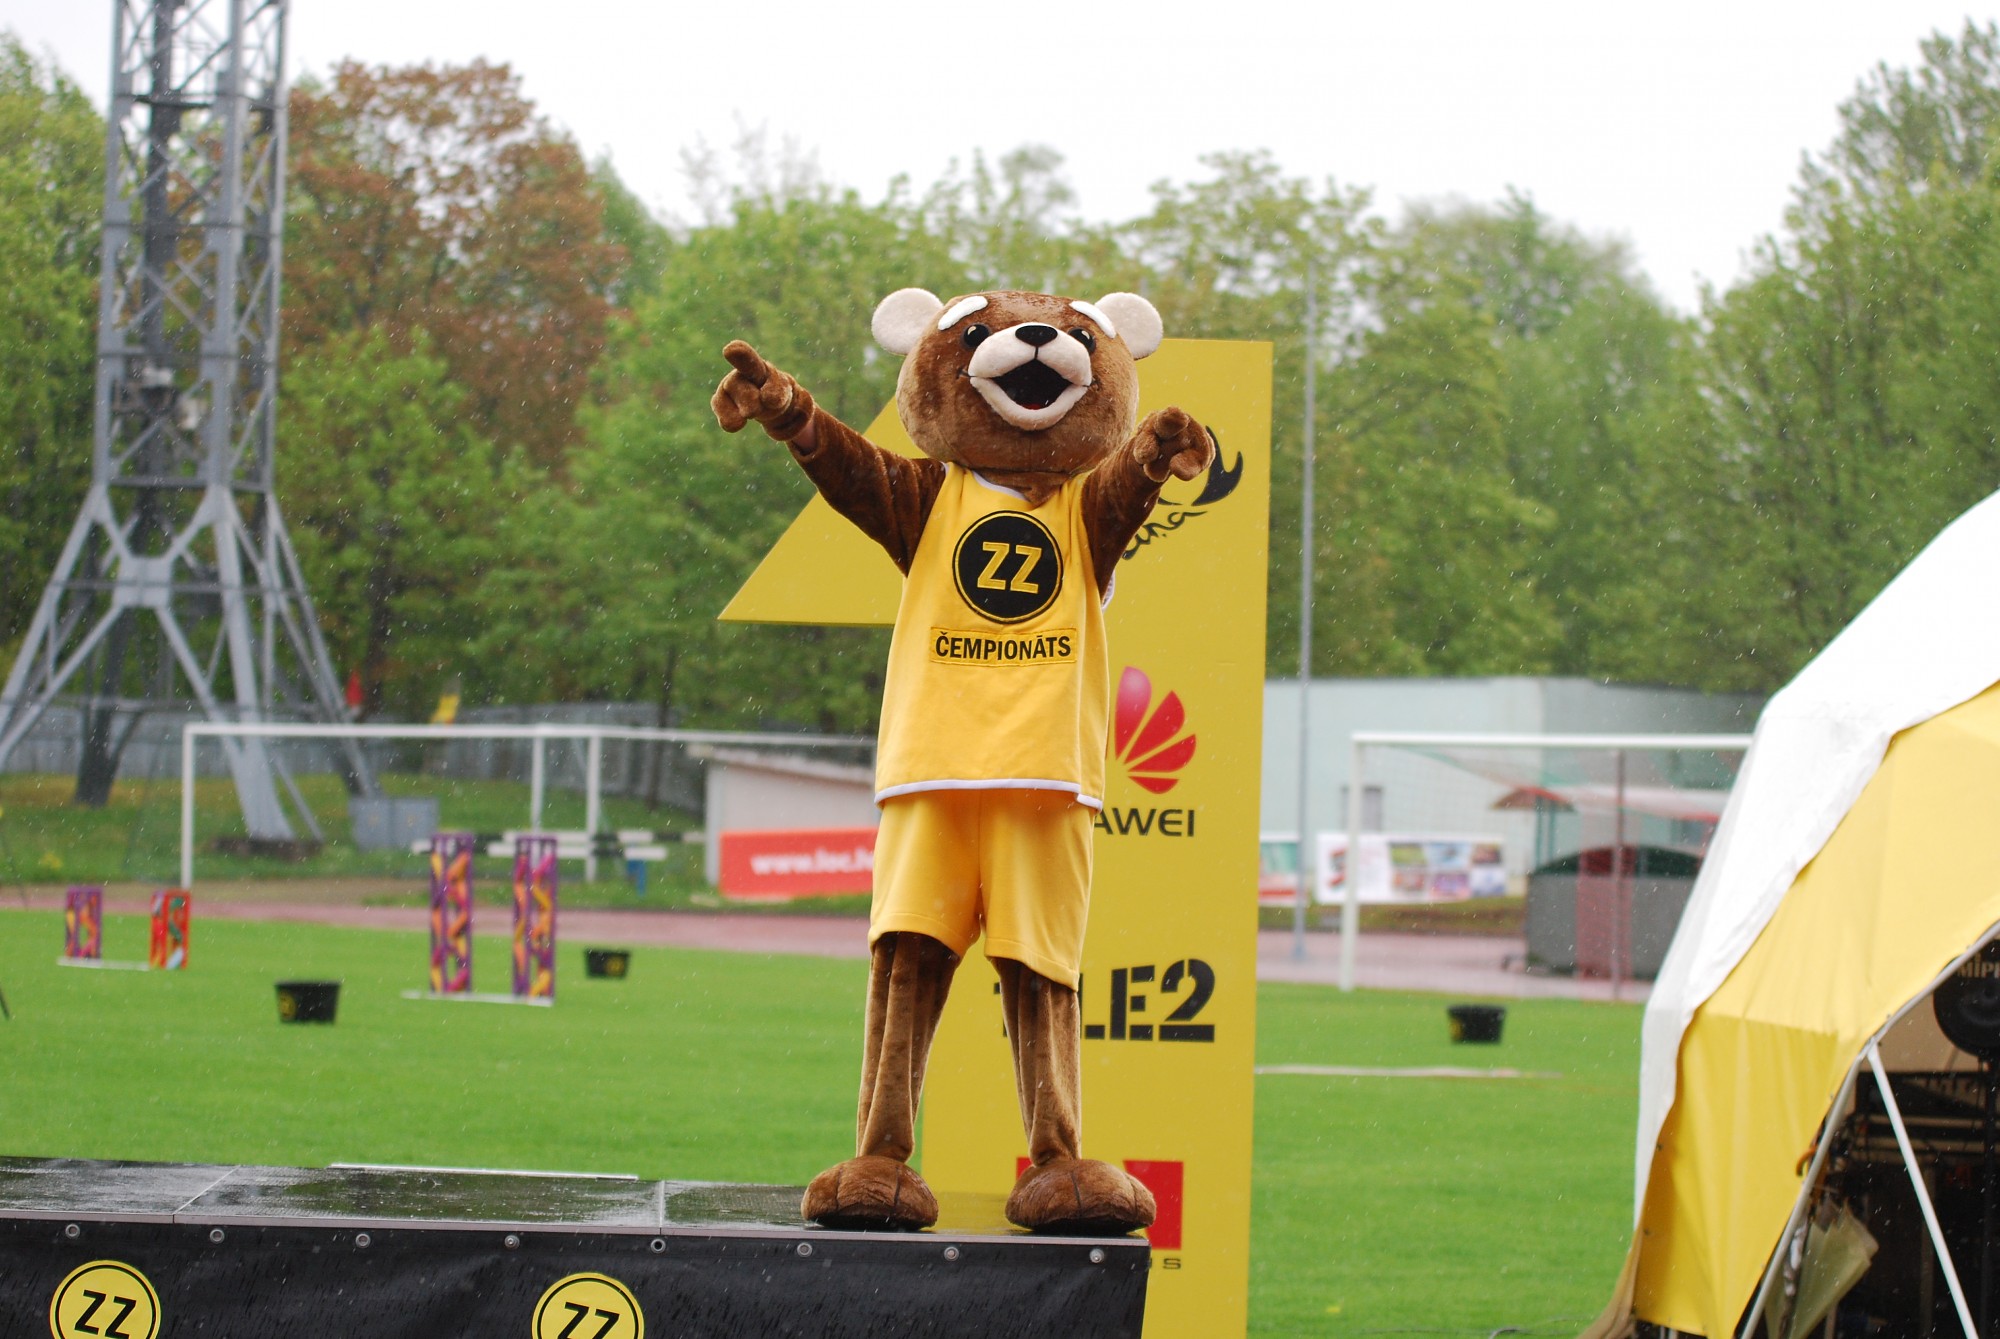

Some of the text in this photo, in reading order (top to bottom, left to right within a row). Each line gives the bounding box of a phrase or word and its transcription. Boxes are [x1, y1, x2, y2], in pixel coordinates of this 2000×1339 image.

[977, 541, 1042, 594] ZZ
[935, 631, 1071, 661] ČEMPIONĀTS
[1094, 807, 1195, 837] AWEI
[74, 1289, 137, 1339] ZZ
